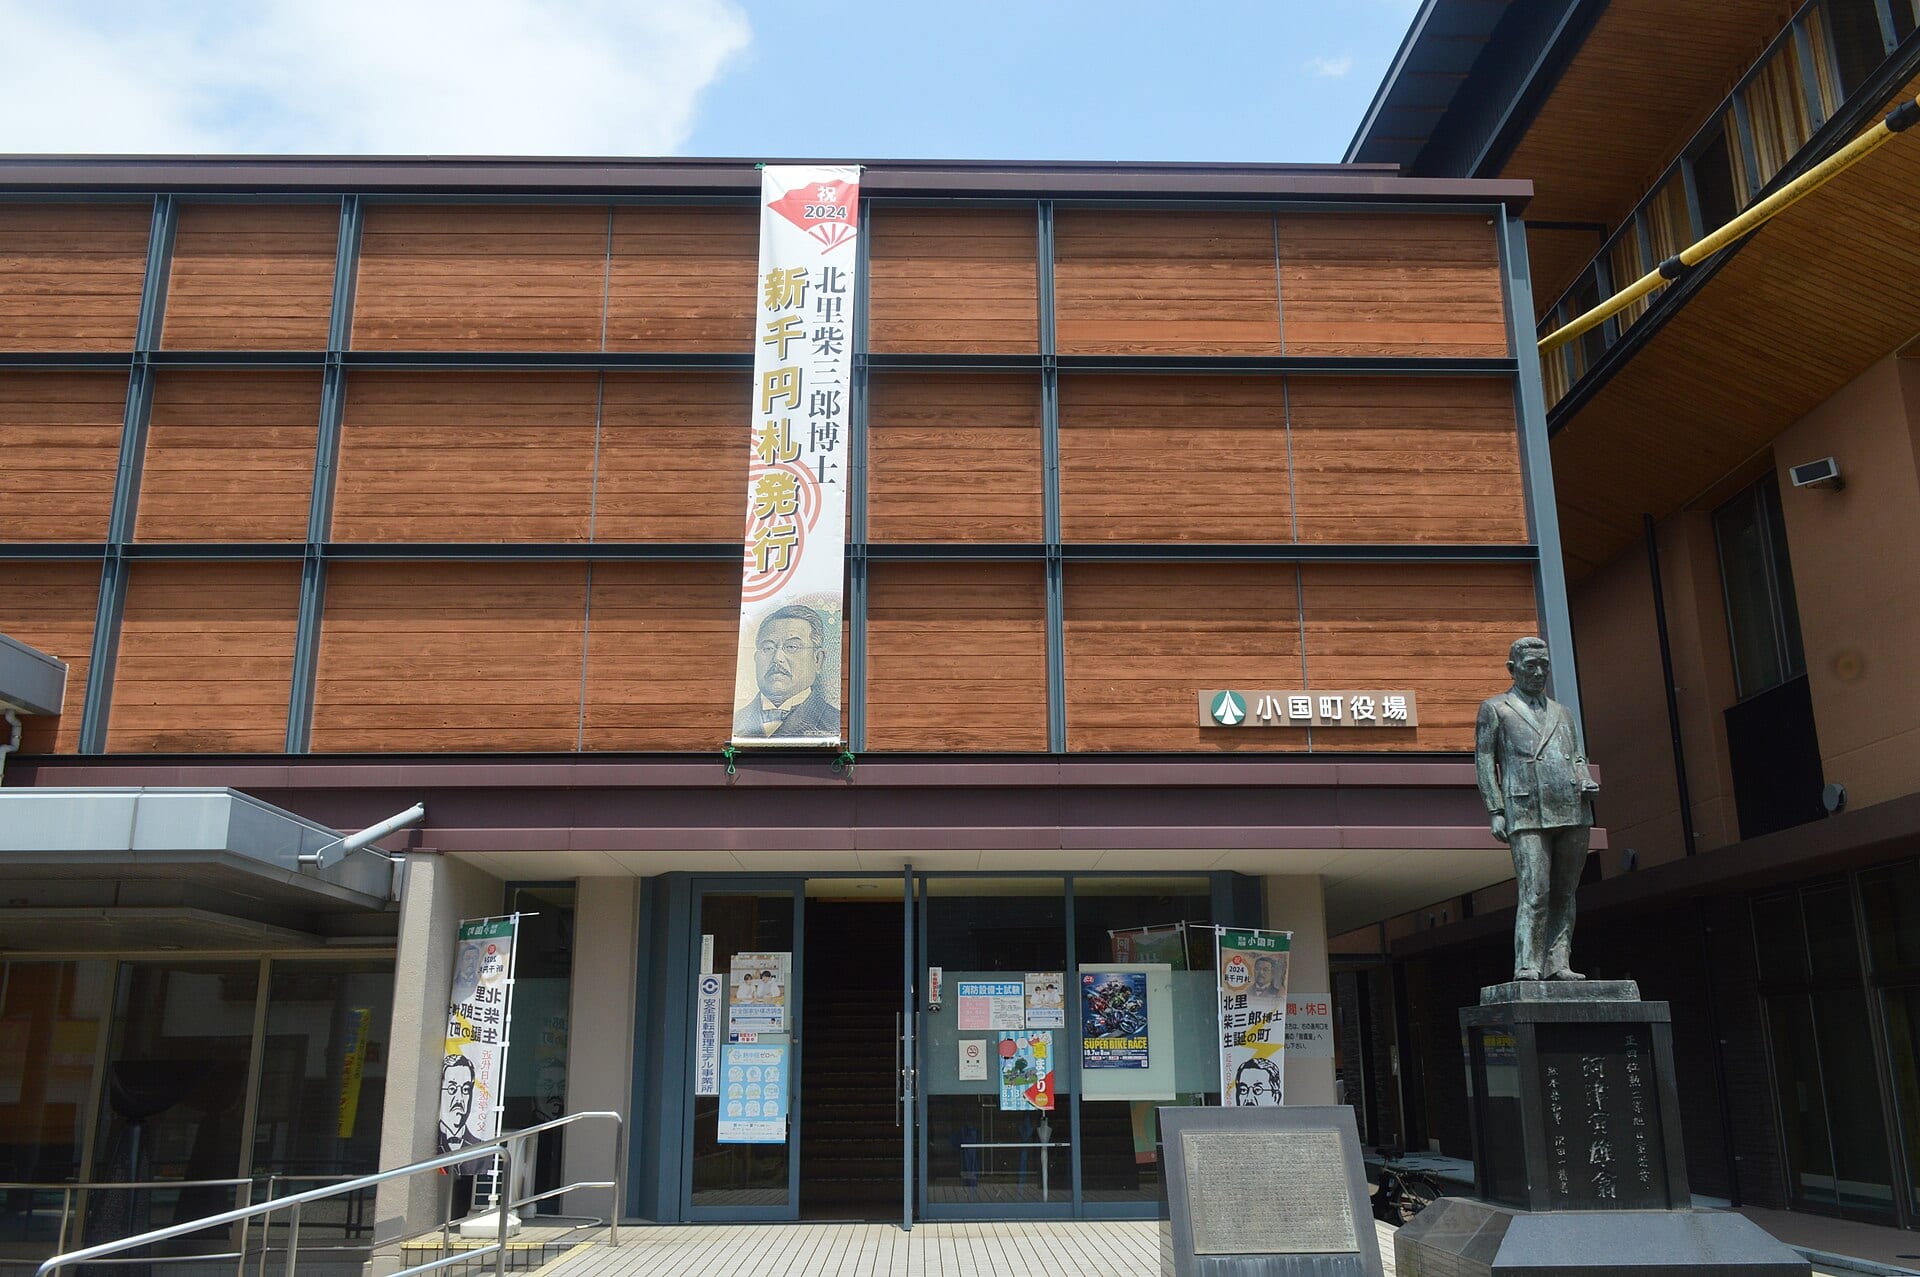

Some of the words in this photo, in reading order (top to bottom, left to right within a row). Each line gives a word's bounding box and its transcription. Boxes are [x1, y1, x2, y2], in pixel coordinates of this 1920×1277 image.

[817, 186, 837, 202] 祝
[804, 205, 848, 219] 2024
[807, 266, 847, 485] 北里柴三郎博士
[752, 266, 810, 574] 新千円札発行
[1256, 695, 1408, 720] 小国町役場
[1248, 937, 1275, 948] 小国町
[962, 985, 1020, 995] 消防設備士試験
[1223, 994, 1248, 1011] 北里
[1223, 1010, 1283, 1030] 柴三郎博士
[701, 998, 716, 1093] 安全運転管理モデル事業所
[1084, 1039, 1108, 1049] SUPER
[1109, 1039, 1127, 1049] BIKE
[1128, 1039, 1147, 1049] RACE
[1223, 1028, 1271, 1048] 生誕の町
